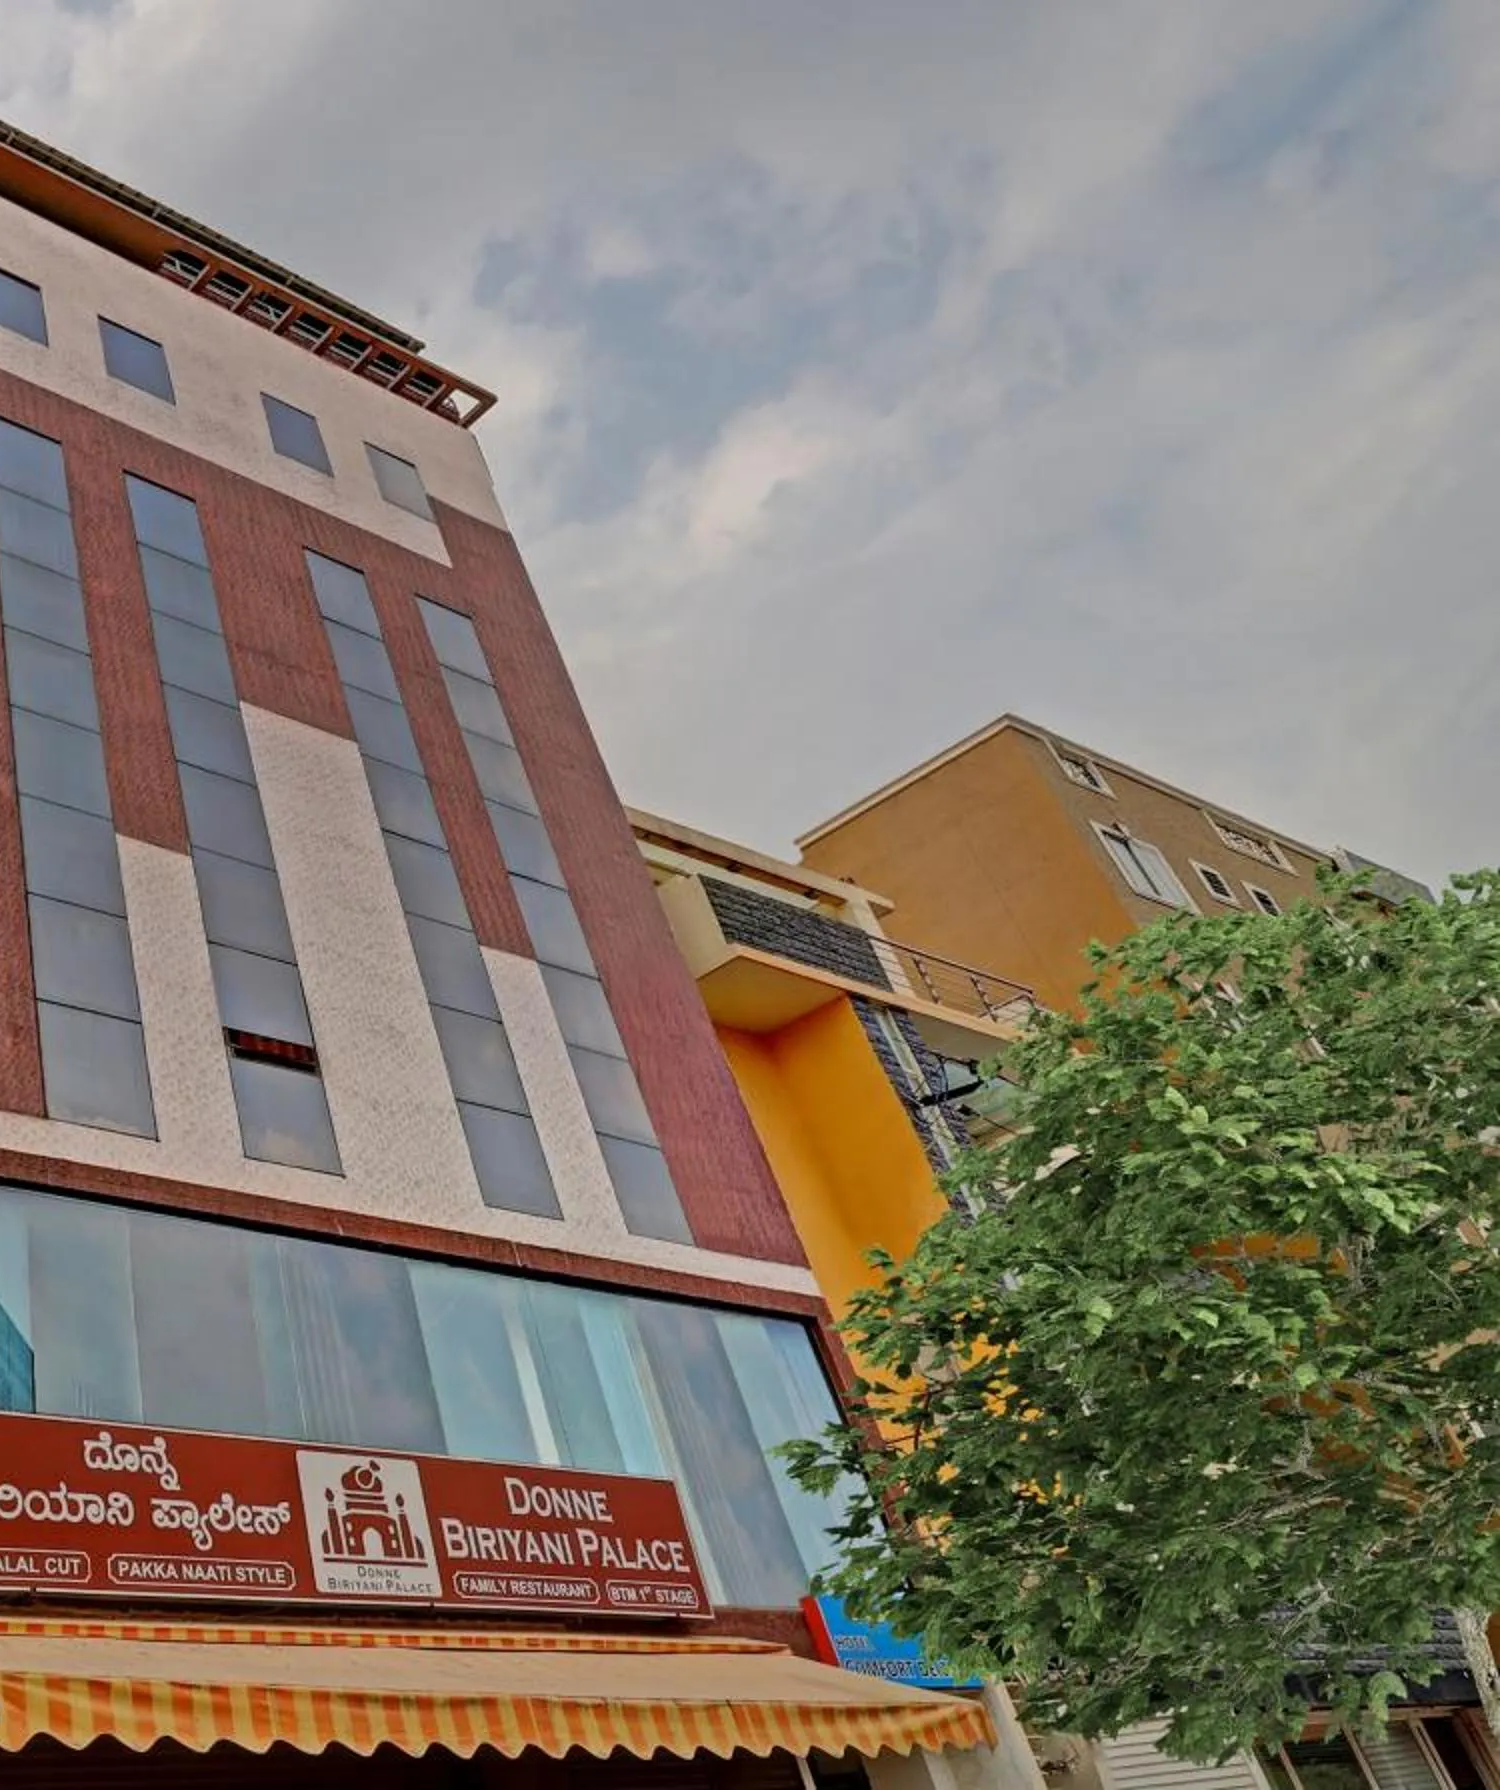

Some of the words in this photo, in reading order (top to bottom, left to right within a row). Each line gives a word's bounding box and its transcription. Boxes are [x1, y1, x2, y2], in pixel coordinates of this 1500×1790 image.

[83, 1431, 181, 1491] ದೊನ್ನೆ
[503, 1476, 614, 1524] DONNE
[151, 1492, 291, 1551] ಪ್ಯಾಲೇಸ್
[439, 1517, 575, 1566] BIRIYANI
[576, 1527, 691, 1573] PALACE
[44, 1557, 81, 1575] CUT
[118, 1561, 178, 1579] PAKKA
[182, 1564, 232, 1582] NAATI
[235, 1567, 287, 1584] STYLE
[357, 1565, 401, 1579] DONNE
[327, 1577, 383, 1590] BIRIYANI
[385, 1579, 433, 1593] PALACE
[460, 1577, 509, 1594] FAMILY
[511, 1580, 592, 1598] RESTAURANT
[611, 1586, 636, 1601] BTM
[655, 1588, 695, 1604] STAGE
